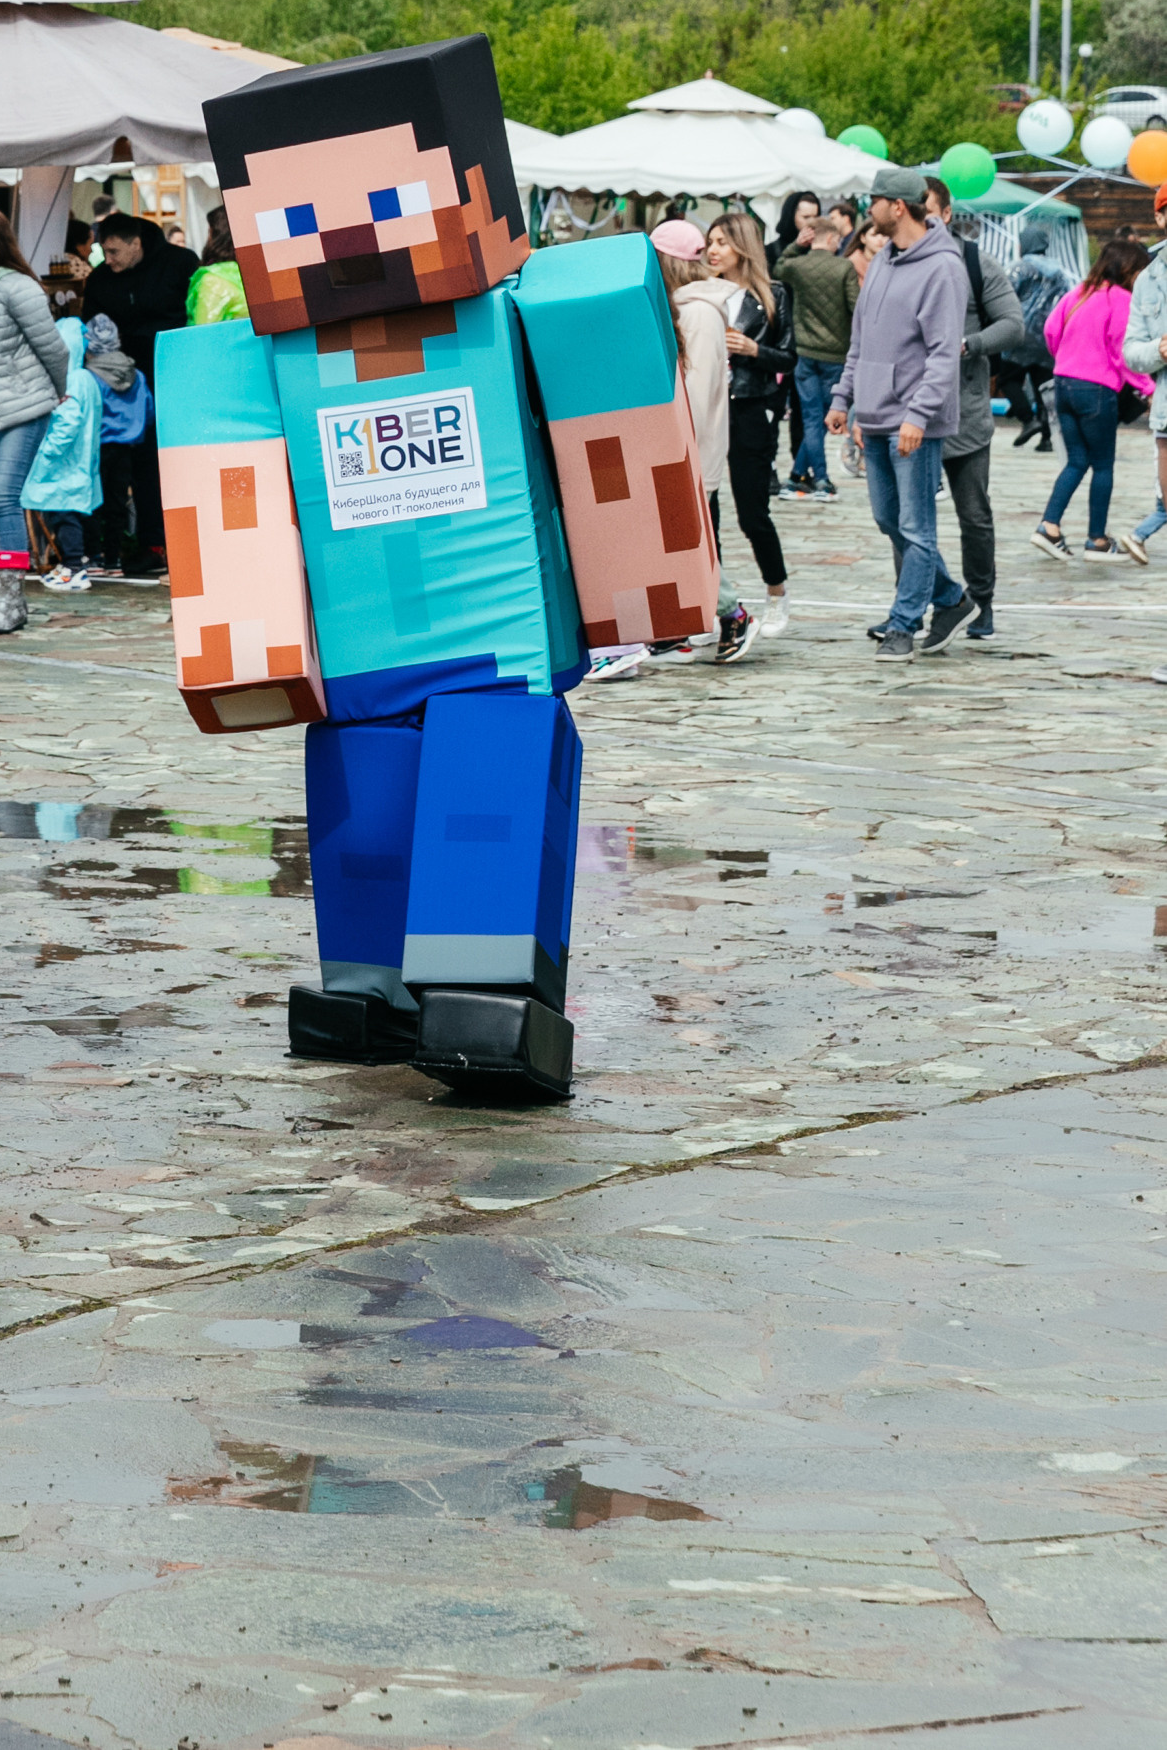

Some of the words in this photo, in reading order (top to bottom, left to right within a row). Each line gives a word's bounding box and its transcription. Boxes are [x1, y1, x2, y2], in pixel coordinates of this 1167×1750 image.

[380, 436, 464, 471] ONE
[333, 491, 401, 509] КиберШкола
[405, 484, 457, 501] будущего
[461, 480, 480, 493] для
[352, 508, 388, 521] нового
[392, 497, 464, 515] IT-поколения
